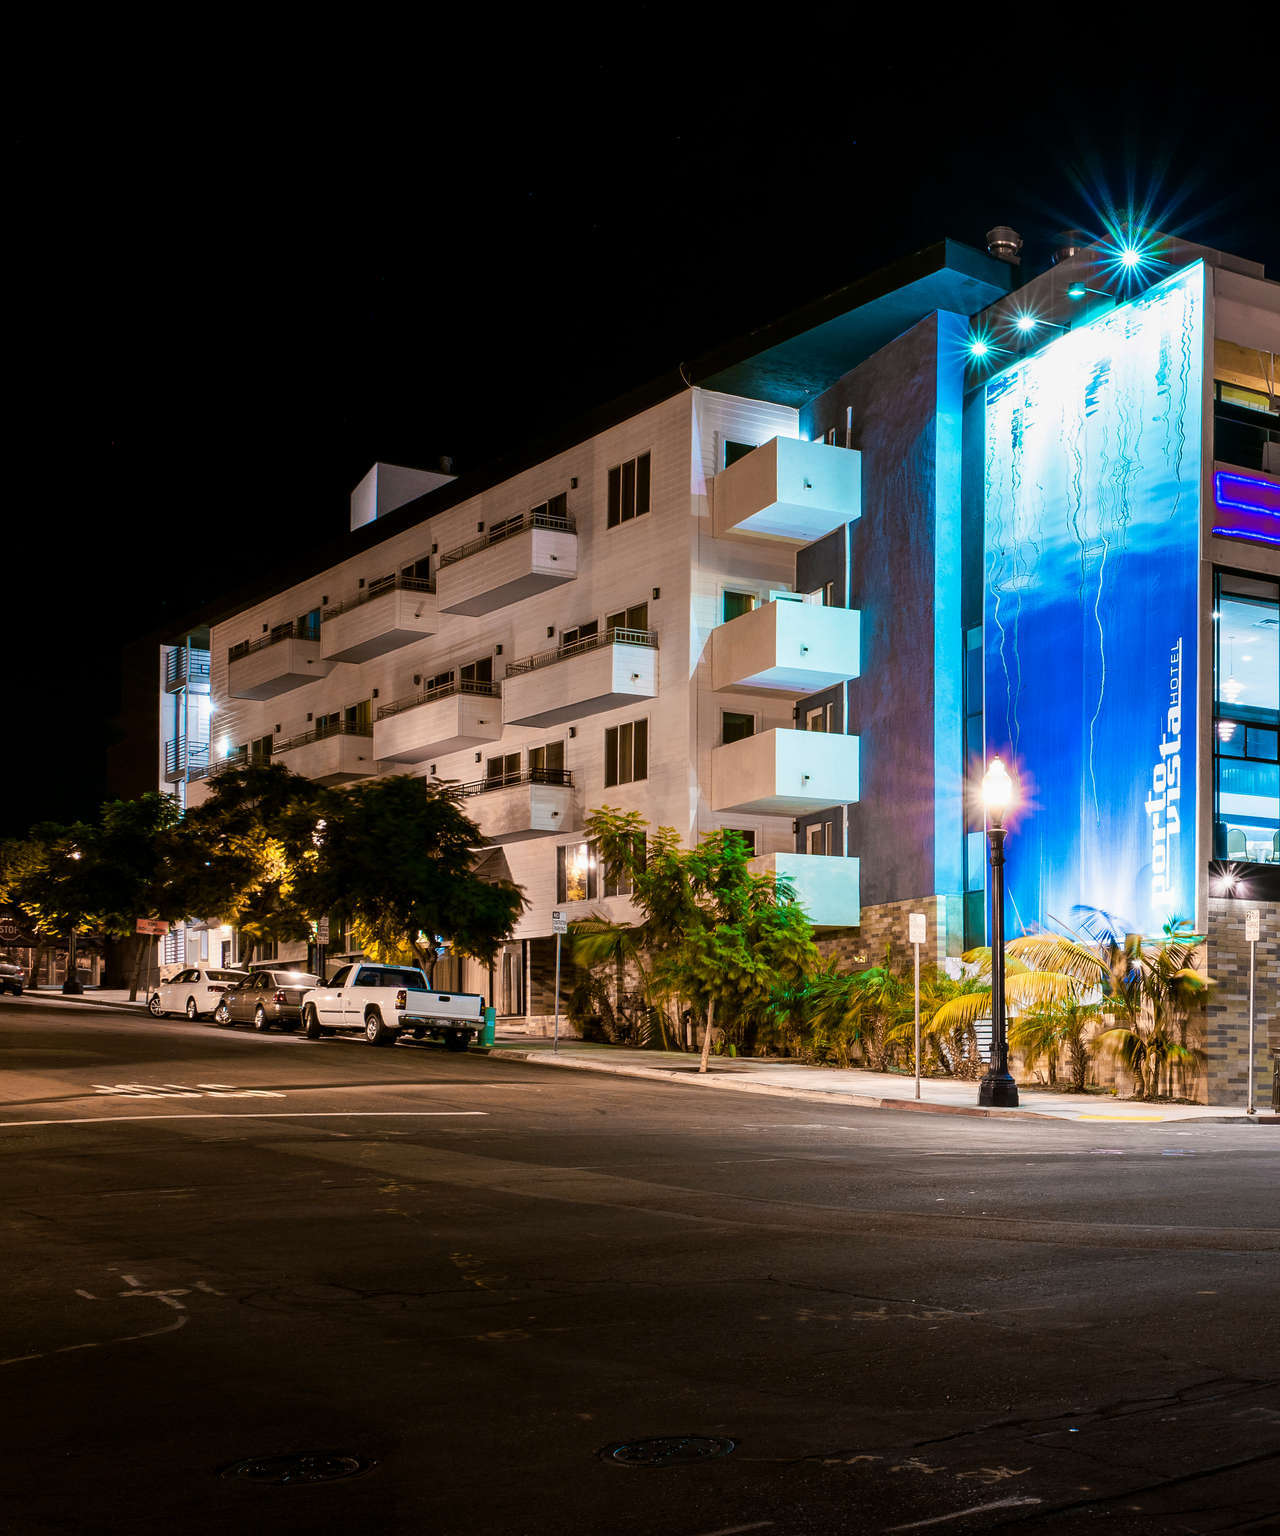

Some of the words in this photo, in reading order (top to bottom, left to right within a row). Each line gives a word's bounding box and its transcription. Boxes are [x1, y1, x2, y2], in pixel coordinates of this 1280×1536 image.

[1169, 640, 1180, 706] HOTEL
[1144, 762, 1172, 909] porto
[1159, 706, 1182, 838] vista
